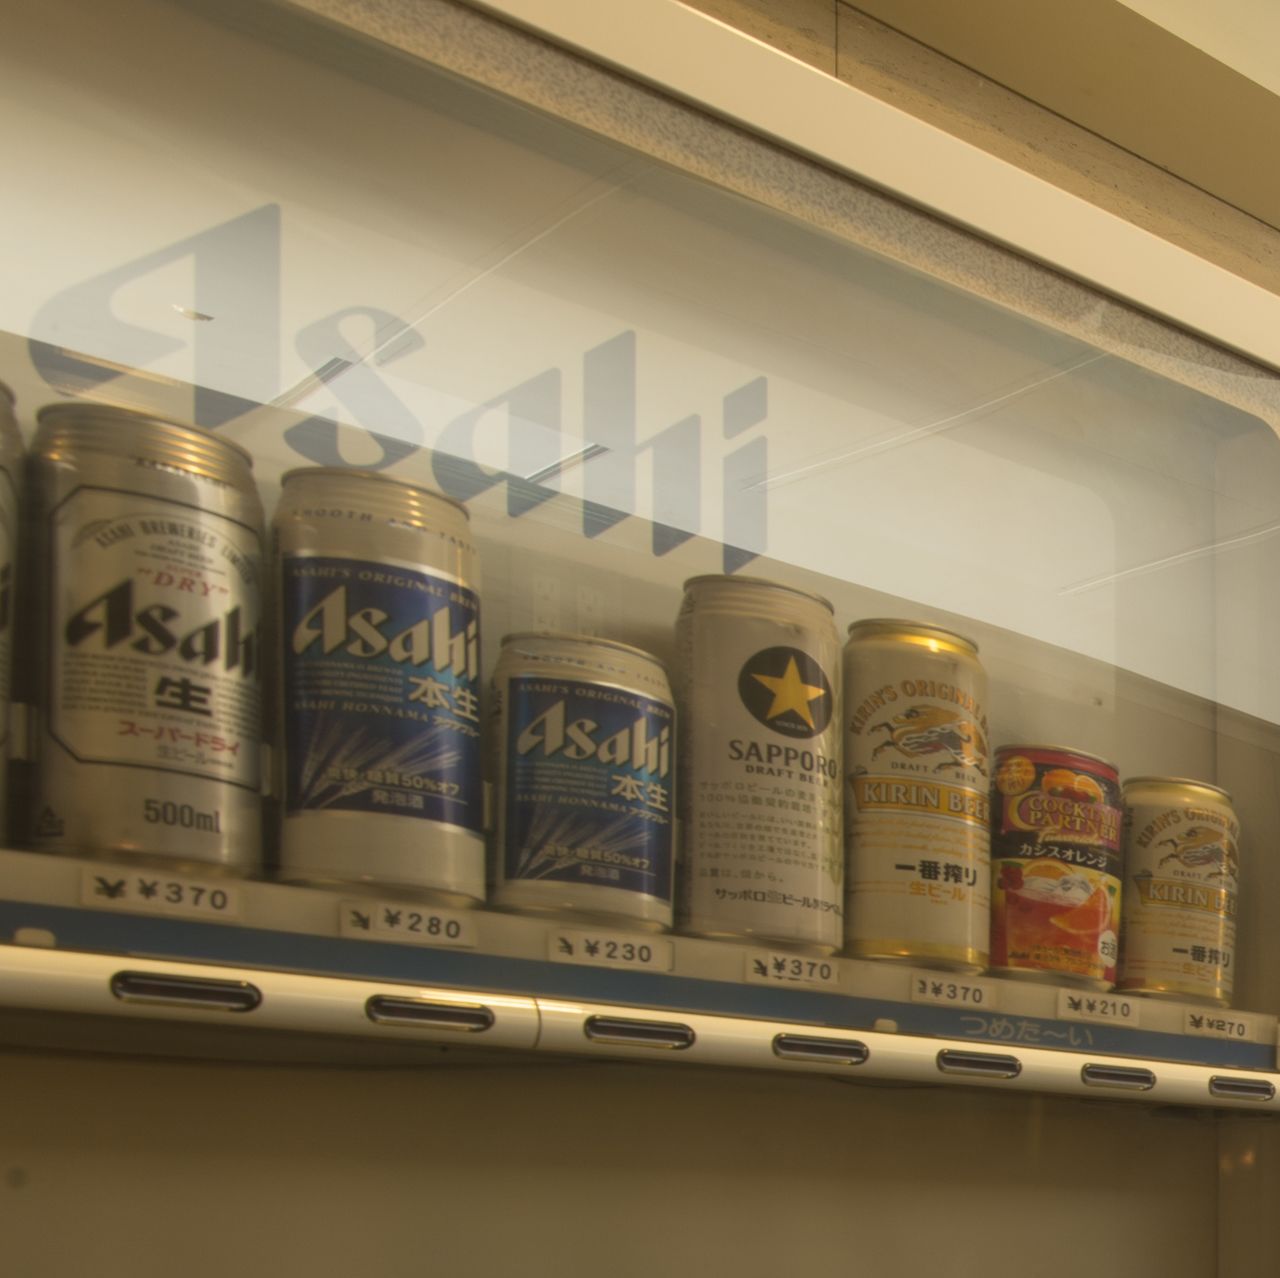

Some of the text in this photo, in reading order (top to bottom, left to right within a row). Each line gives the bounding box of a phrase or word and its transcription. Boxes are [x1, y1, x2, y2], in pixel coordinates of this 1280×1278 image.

[28, 203, 768, 576] Asahi
[292, 585, 477, 682] Asahi
[155, 677, 212, 717] 生
[408, 676, 480, 722] 本生
[117, 720, 241, 755] スーパードライ
[517, 700, 669, 780] Asahi
[728, 739, 838, 780] SAPPORO
[745, 764, 793, 780] DRAFT
[611, 774, 669, 812] 本生
[862, 781, 940, 809] KIRIN
[144, 799, 221, 833] 500ml
[1019, 843, 1108, 868] カシスオレンジ
[895, 859, 977, 887] 一番搾り
[138, 878, 228, 910] ¥370
[909, 882, 966, 902] 生ビール
[1150, 884, 1208, 905] KIRIN
[384, 908, 461, 939] ¥280
[584, 938, 652, 963] ¥230
[1172, 944, 1230, 967] 一番搾り
[773, 956, 832, 980] ¥370
[931, 980, 983, 1003] ¥370
[1086, 997, 1131, 1017] ¥210
